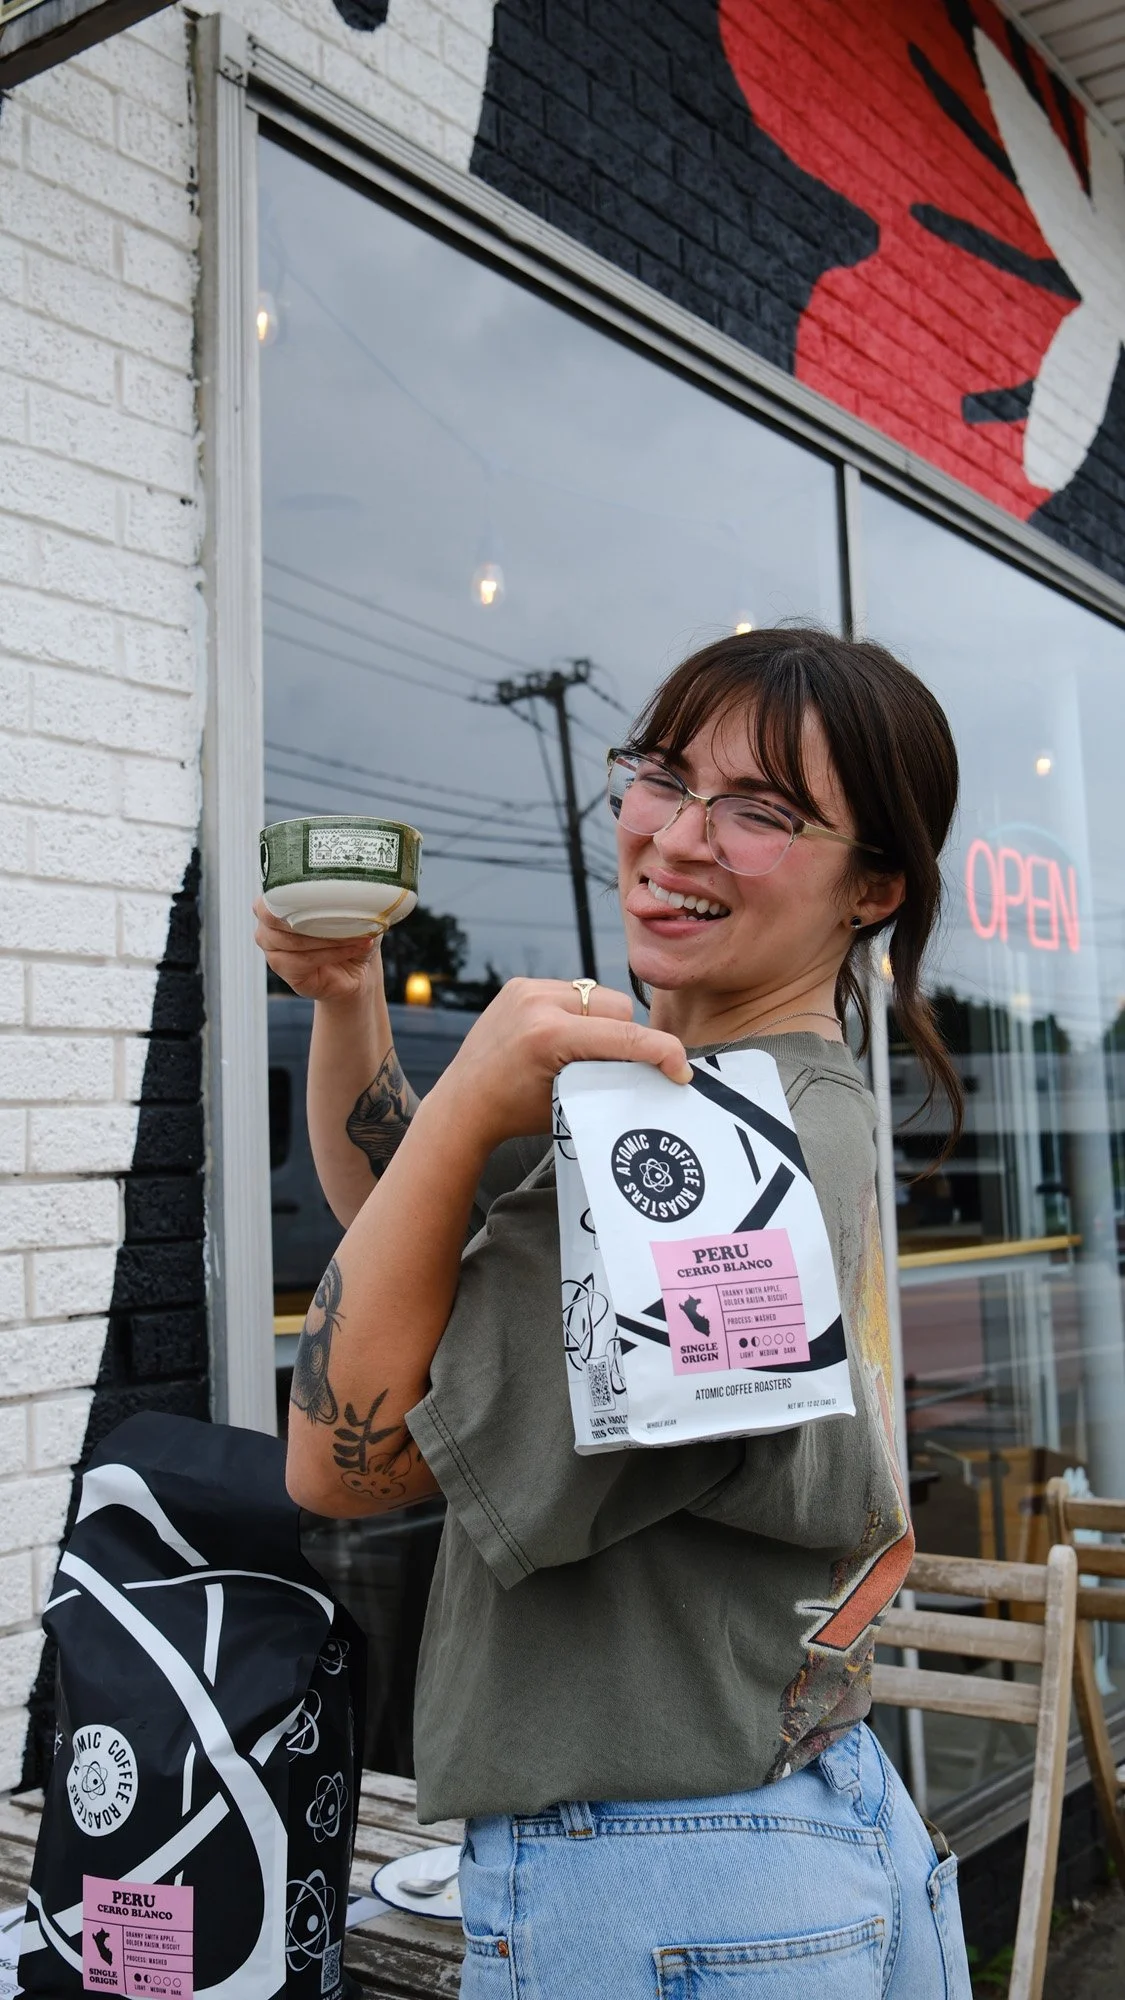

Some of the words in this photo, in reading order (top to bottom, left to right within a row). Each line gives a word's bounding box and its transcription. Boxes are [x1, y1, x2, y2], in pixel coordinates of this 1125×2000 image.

[965, 838, 1080, 953] OPEN
[615, 1133, 650, 1177] ATOMIC
[659, 1136, 701, 1188] COFFEE
[623, 1182, 698, 1218] ROASTERS
[692, 1243, 750, 1264] PERU
[677, 1264, 720, 1278] CERRO
[723, 1259, 773, 1273] BLANCO
[755, 1313, 777, 1323] WASHED
[680, 1342, 718, 1354] SINGLE
[740, 1351, 754, 1359] LIGHT
[759, 1349, 779, 1357] MEDIUM
[681, 1352, 719, 1364] ORIGIN
[695, 1387, 724, 1401] ATOMIC
[725, 1382, 753, 1397] COFFEE
[754, 1377, 792, 1393] ROASTERS
[591, 1429, 607, 1439] THIS
[108, 1739, 133, 1804] COFFEE
[70, 1784, 122, 1829] ROASTERS
[112, 1890, 156, 1908] PERU
[97, 1904, 129, 1916] CERRO
[131, 1908, 173, 1920] BLANCO
[148, 1957, 167, 1966] WASHED
[89, 1967, 118, 1978] SINGLE
[89, 1975, 118, 1986] ORIGIN
